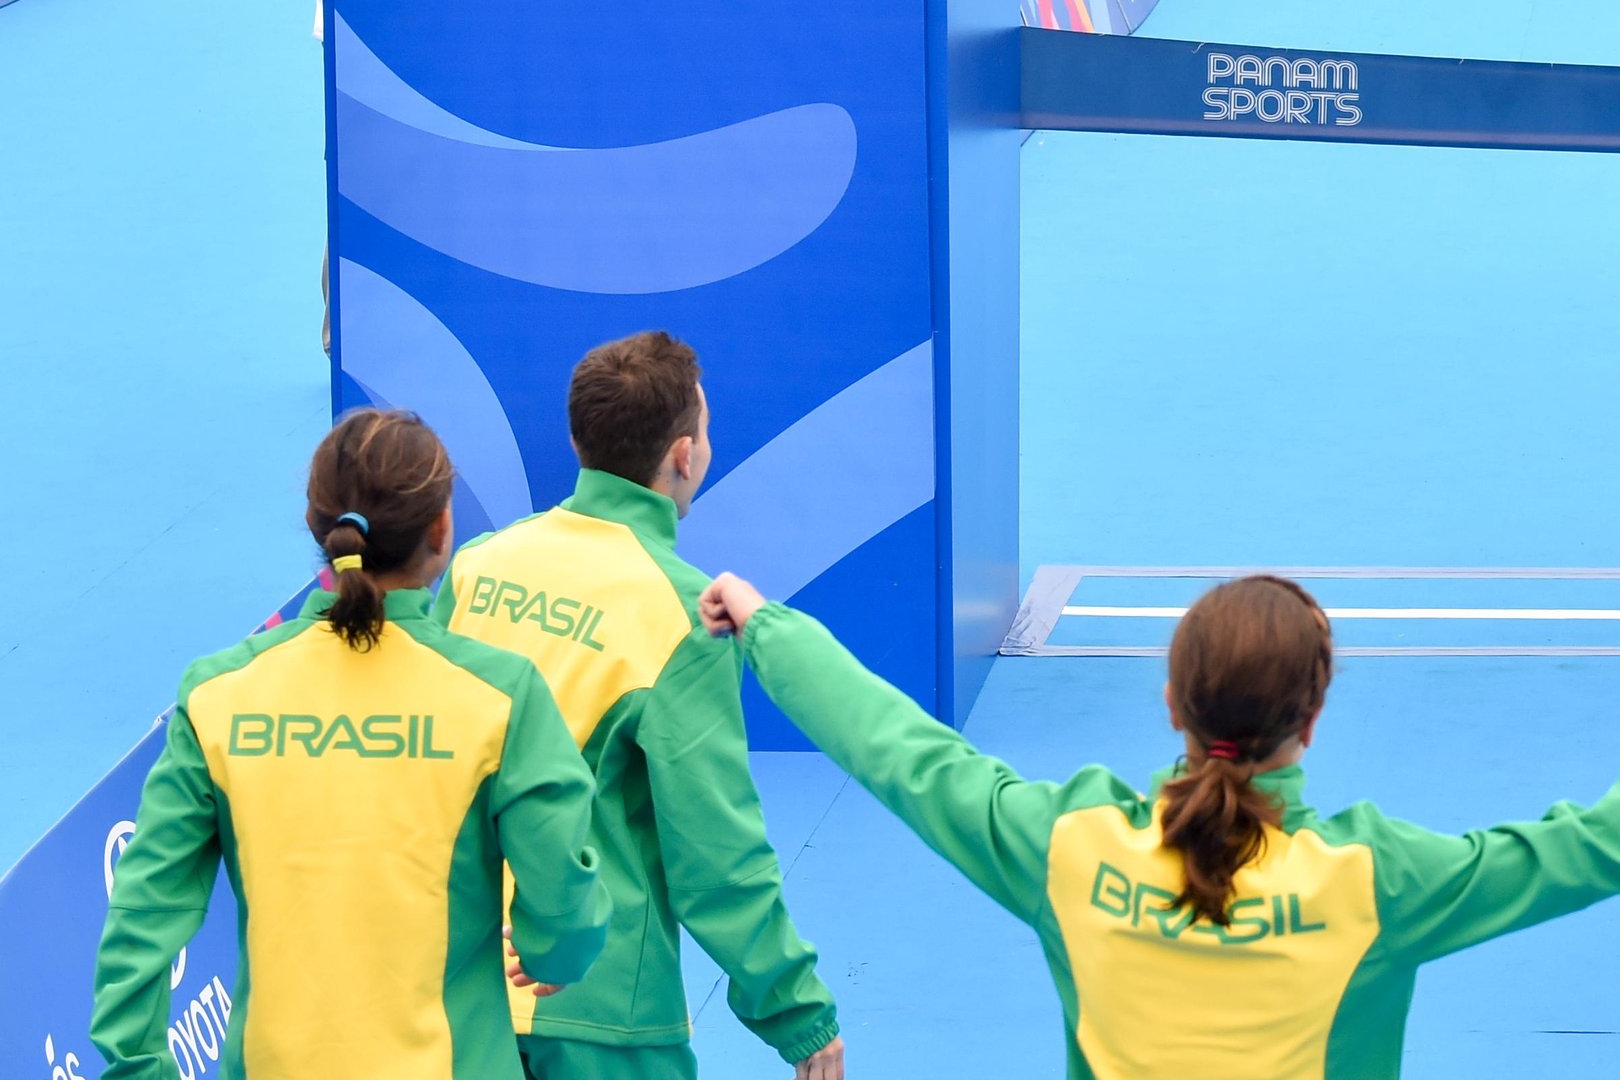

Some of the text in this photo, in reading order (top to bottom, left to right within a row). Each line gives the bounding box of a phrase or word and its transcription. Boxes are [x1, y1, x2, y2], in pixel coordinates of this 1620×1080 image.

[1207, 52, 1358, 91] PANAM
[1201, 86, 1363, 127] SPORTS
[468, 575, 605, 652] BRASIL
[228, 713, 454, 759] BRASIL
[167, 975, 233, 1080] OYOTA
